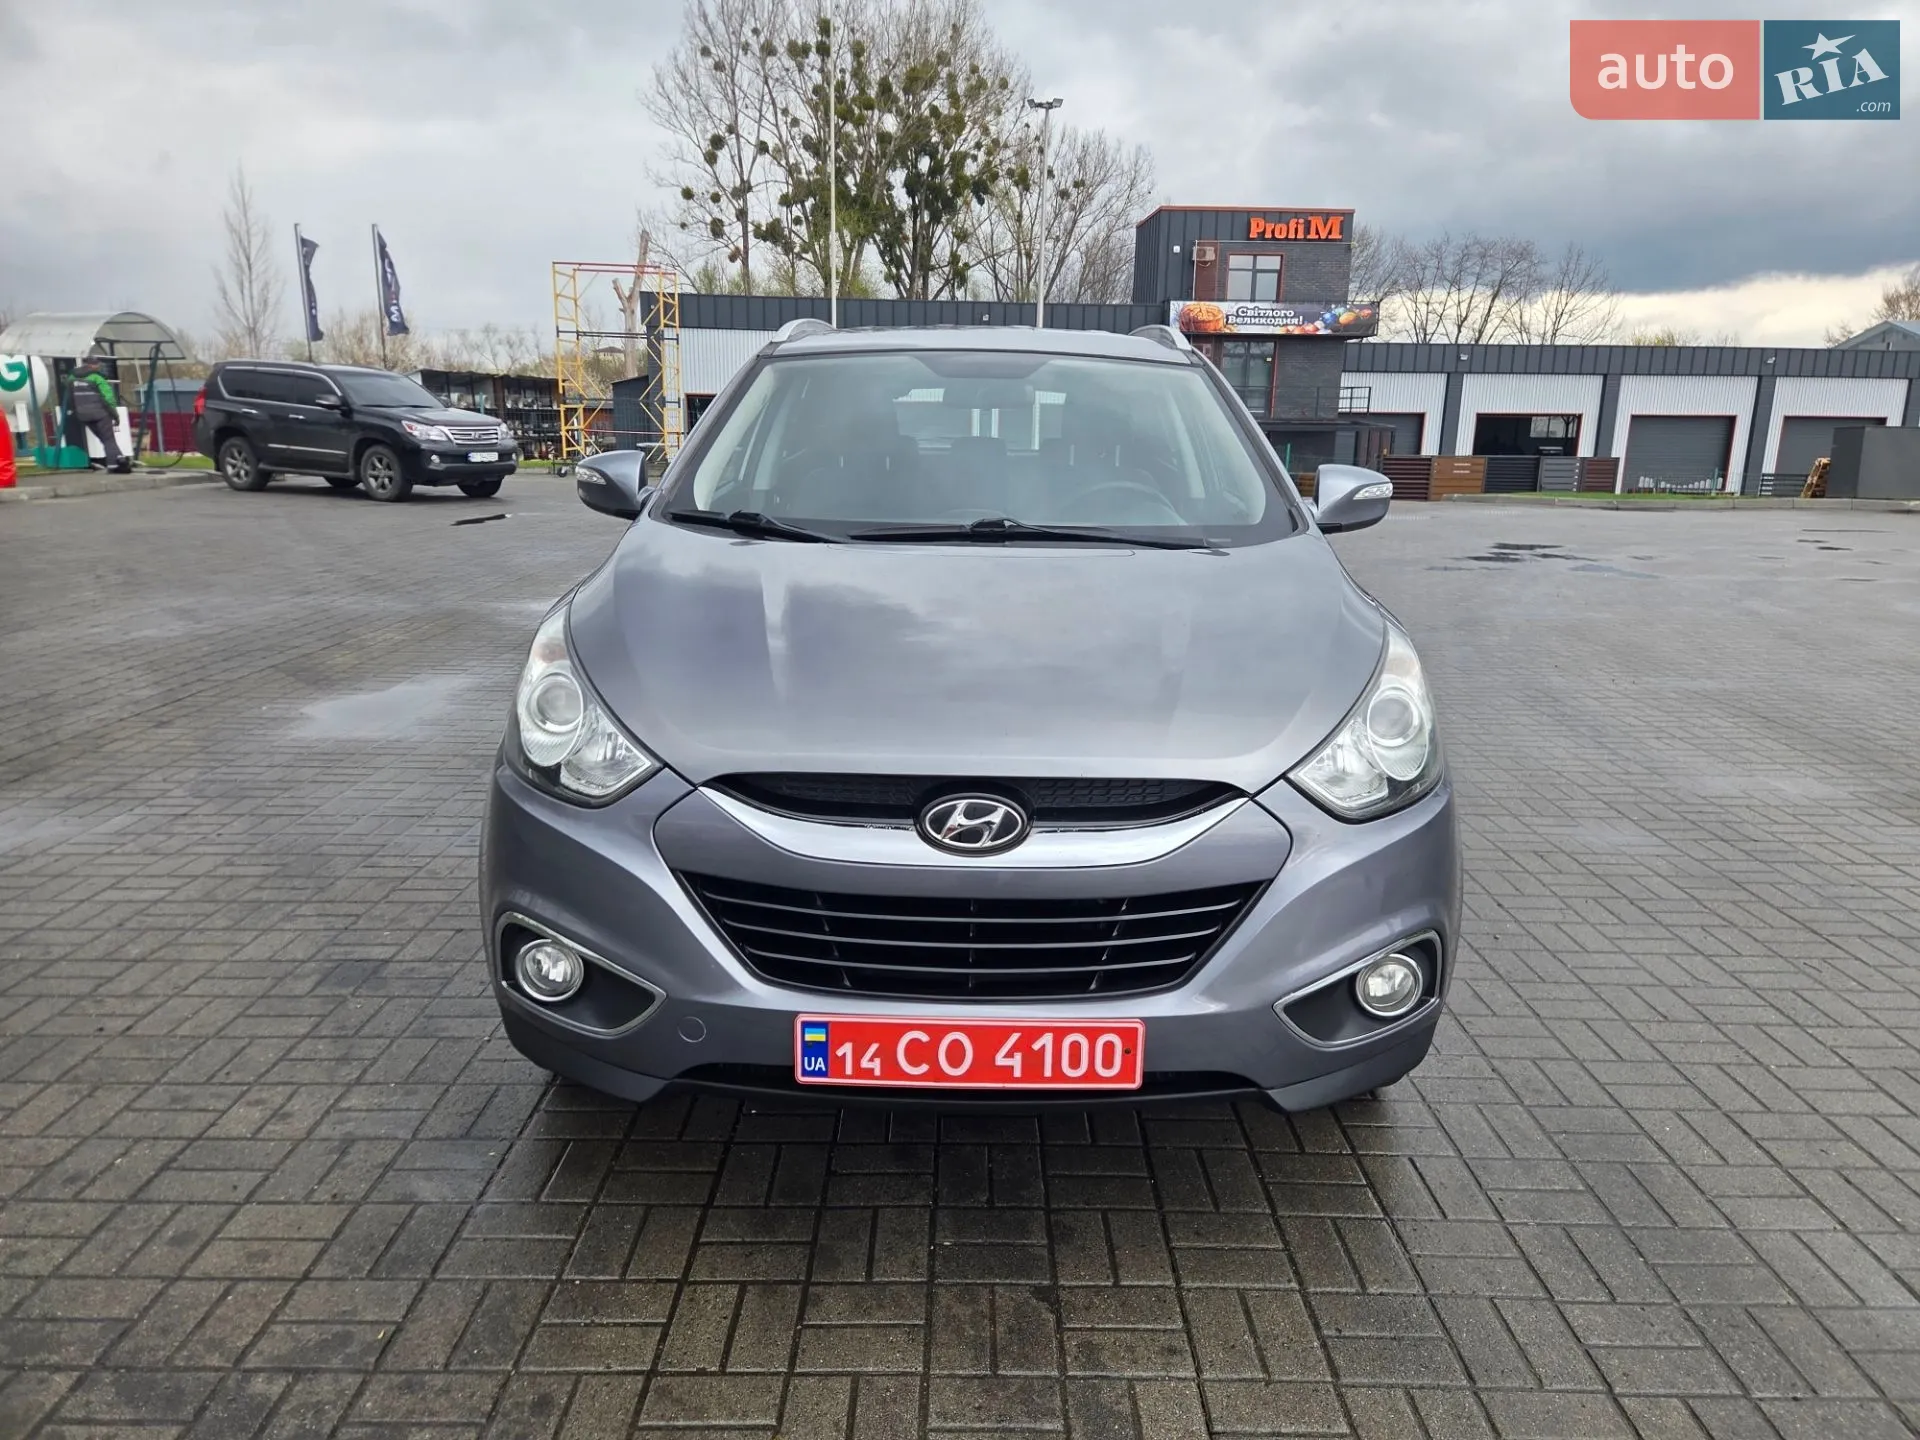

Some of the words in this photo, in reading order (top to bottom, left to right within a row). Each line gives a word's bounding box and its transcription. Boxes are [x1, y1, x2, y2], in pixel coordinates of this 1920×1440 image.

[1237, 307, 1295, 317] Світлого
[1227, 315, 1304, 326] Великодня!
[835, 1042, 881, 1077] 14
[896, 1030, 974, 1077] CO
[994, 1032, 1123, 1078] 4100
[803, 1056, 826, 1072] UA
